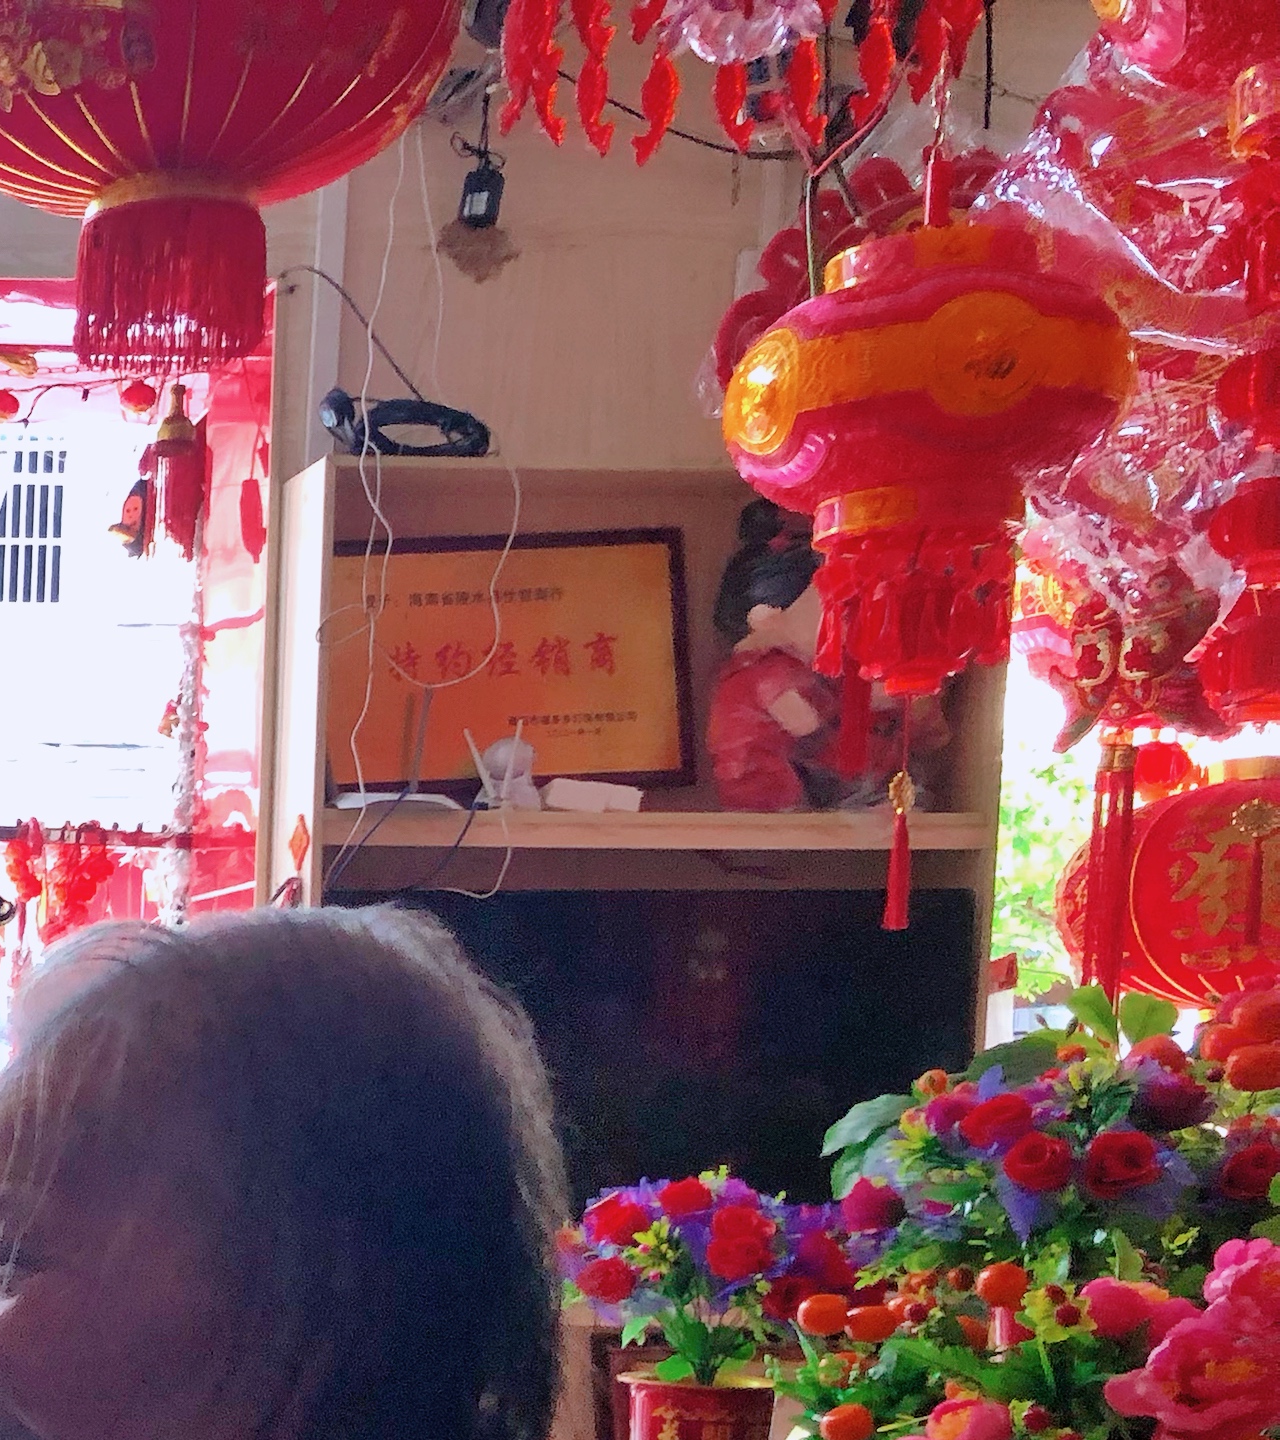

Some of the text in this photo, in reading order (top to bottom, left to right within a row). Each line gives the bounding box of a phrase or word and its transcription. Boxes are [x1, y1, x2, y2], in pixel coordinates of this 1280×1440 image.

[389, 632, 619, 683] 特约经销商
